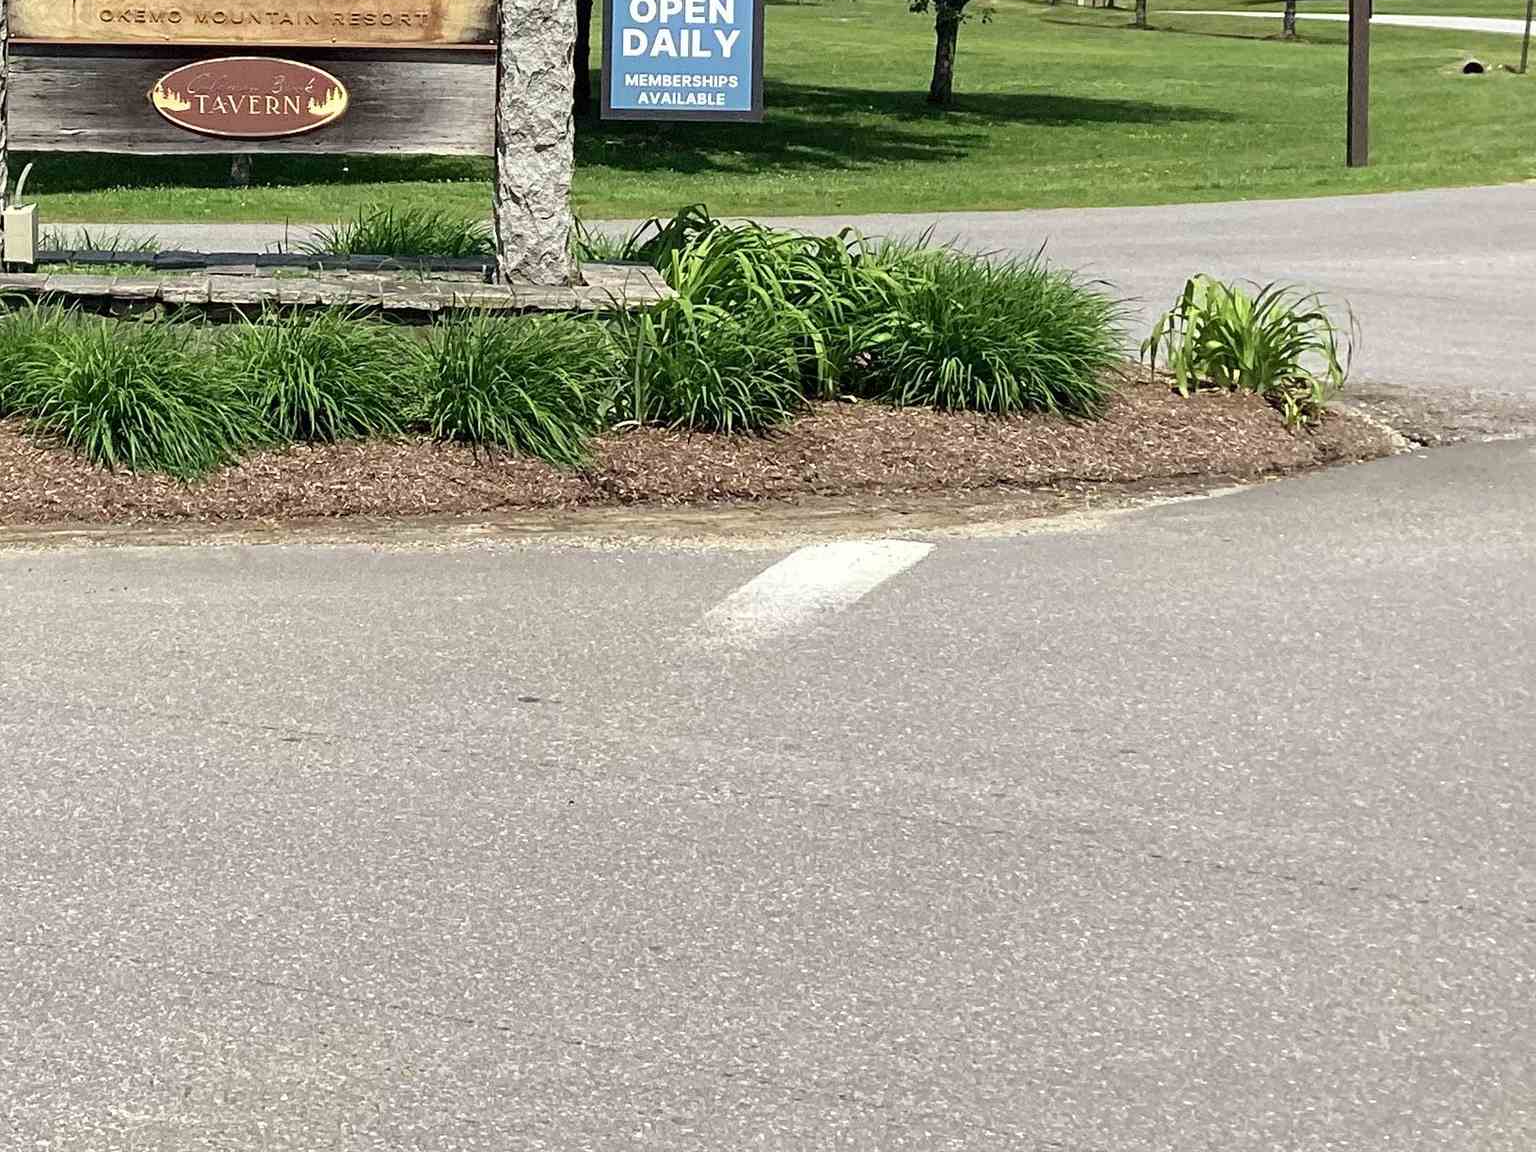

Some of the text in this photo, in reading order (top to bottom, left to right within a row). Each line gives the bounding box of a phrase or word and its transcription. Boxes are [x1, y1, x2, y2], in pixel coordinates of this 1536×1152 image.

[100, 9, 430, 27] OKEMO MOUNTAIN RESORT
[622, 29, 741, 58] DAILY
[625, 74, 738, 87] MEMBERSHIPS
[194, 94, 301, 116] TAVERN
[638, 92, 725, 105] AVAILABLE
